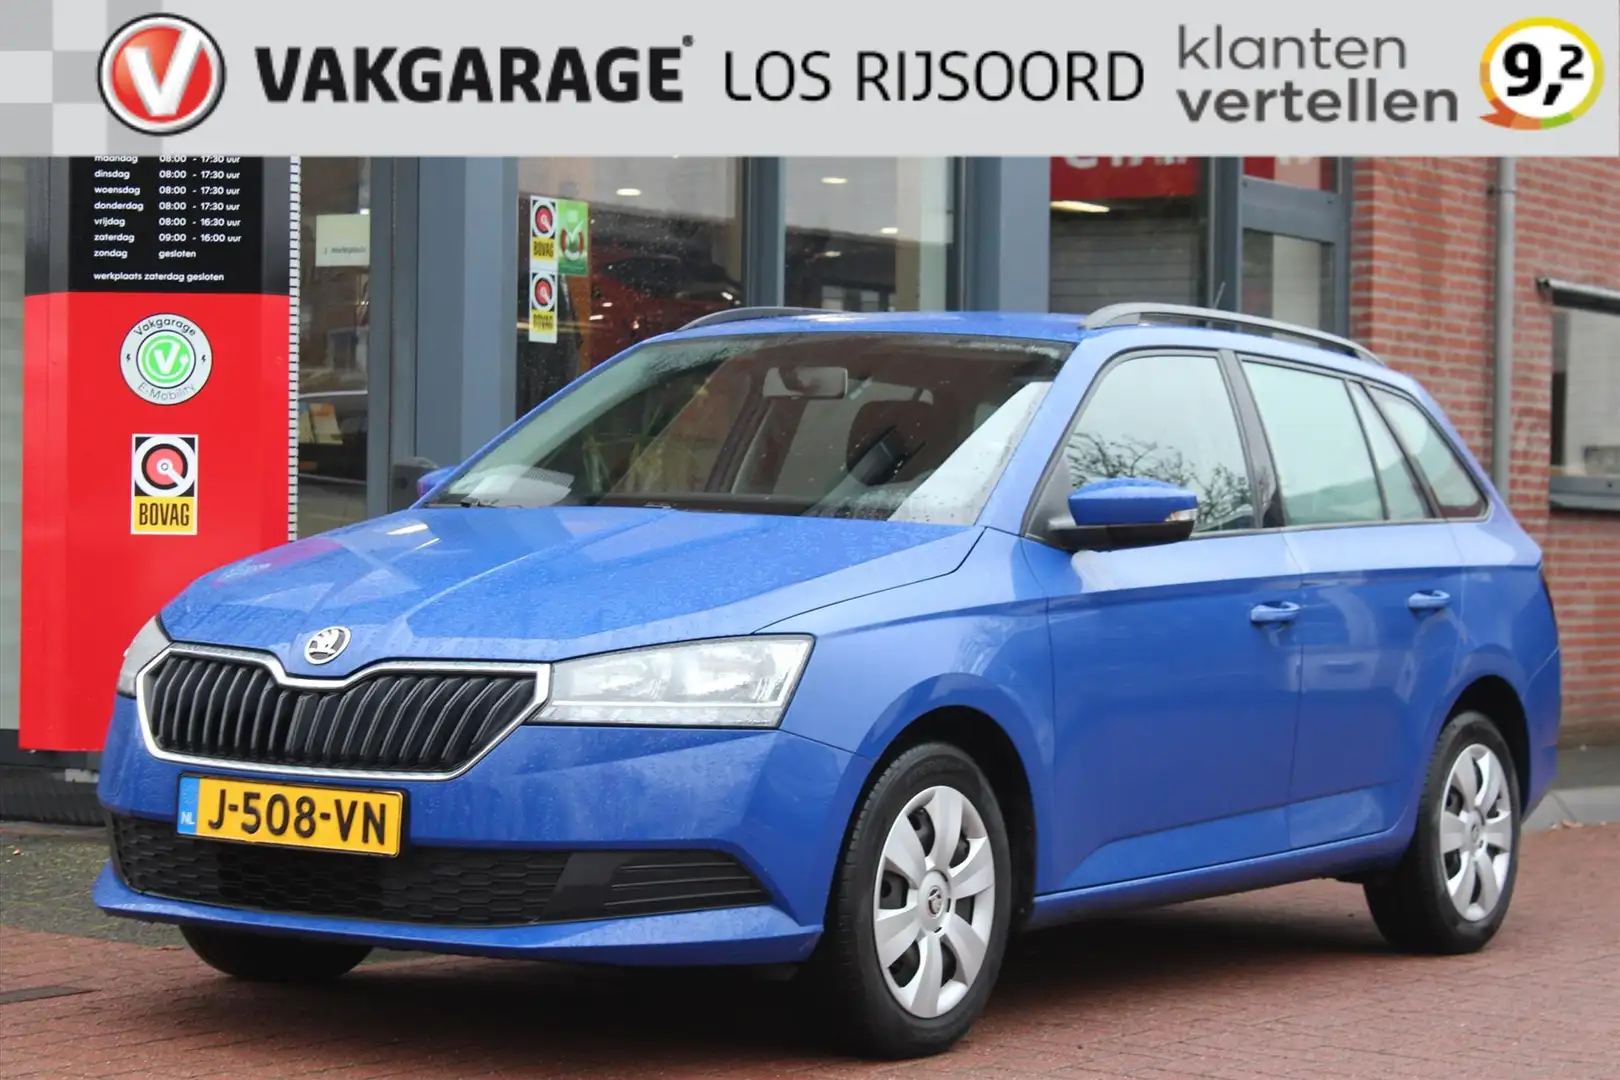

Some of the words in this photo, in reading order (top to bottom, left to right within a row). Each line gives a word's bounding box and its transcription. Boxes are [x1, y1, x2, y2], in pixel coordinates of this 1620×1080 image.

[93, 155, 138, 165] maandag
[159, 155, 187, 163] 08:00
[200, 155, 224, 164] 17:30
[93, 169, 130, 180] dinsdag
[159, 169, 187, 178] 08:00
[200, 169, 224, 179] 17:30
[93, 186, 140, 196] woensdag
[159, 186, 187, 195] 08:00
[200, 186, 224, 196] 17:30
[93, 201, 144, 212] donderdag
[159, 201, 187, 210] 08:00
[200, 201, 224, 211] 17:30
[93, 217, 125, 228] vrijdag
[159, 217, 187, 226] 08:00
[200, 217, 224, 227] 16:30
[93, 233, 135, 243] zaterdag
[159, 233, 187, 242] 09:00
[200, 233, 225, 243] 16:00
[93, 248, 128, 259] zondag
[158, 249, 197, 259] gesloten
[93, 271, 142, 282] werkplaats
[144, 272, 185, 283] zaterdag
[187, 272, 225, 283] gesloten
[133, 317, 197, 337] Vakgarage
[138, 382, 195, 401] E-Mobility
[139, 503, 190, 526] BOVAG
[181, 811, 195, 825] NL
[208, 788, 387, 846] J-508-VN
